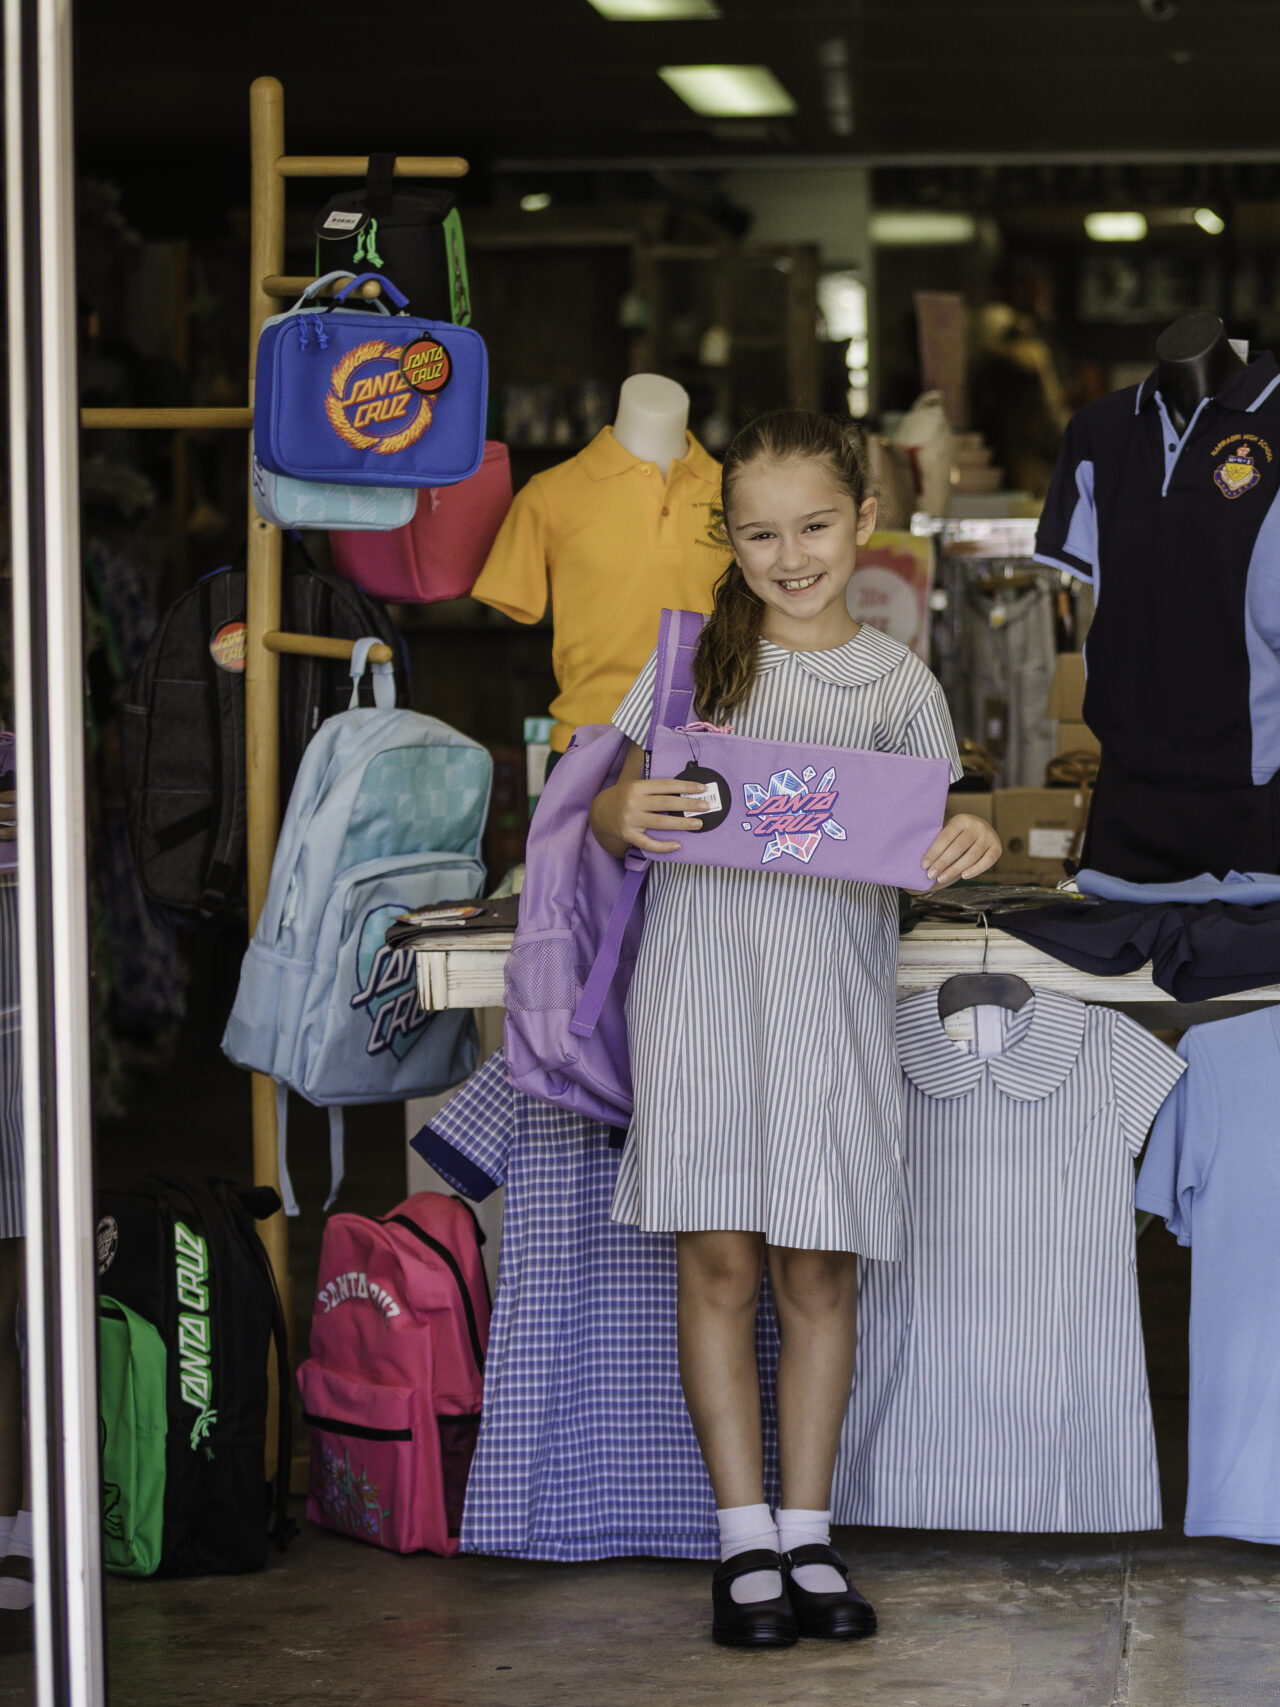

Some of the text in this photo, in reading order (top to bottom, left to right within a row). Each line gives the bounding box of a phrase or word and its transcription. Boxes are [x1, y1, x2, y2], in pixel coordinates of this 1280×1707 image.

[402, 346, 444, 371] SANTA
[411, 362, 444, 386] CRUZ
[352, 392, 413, 430] CRUZ
[214, 629, 247, 651] SANT
[221, 647, 247, 665] CRU
[746, 790, 839, 817] SANTA
[753, 811, 833, 837] CRUZ
[366, 988, 434, 1054] CRU
[317, 1271, 369, 1315] SANTA
[174, 1221, 212, 1416] SANTA CRUZ
